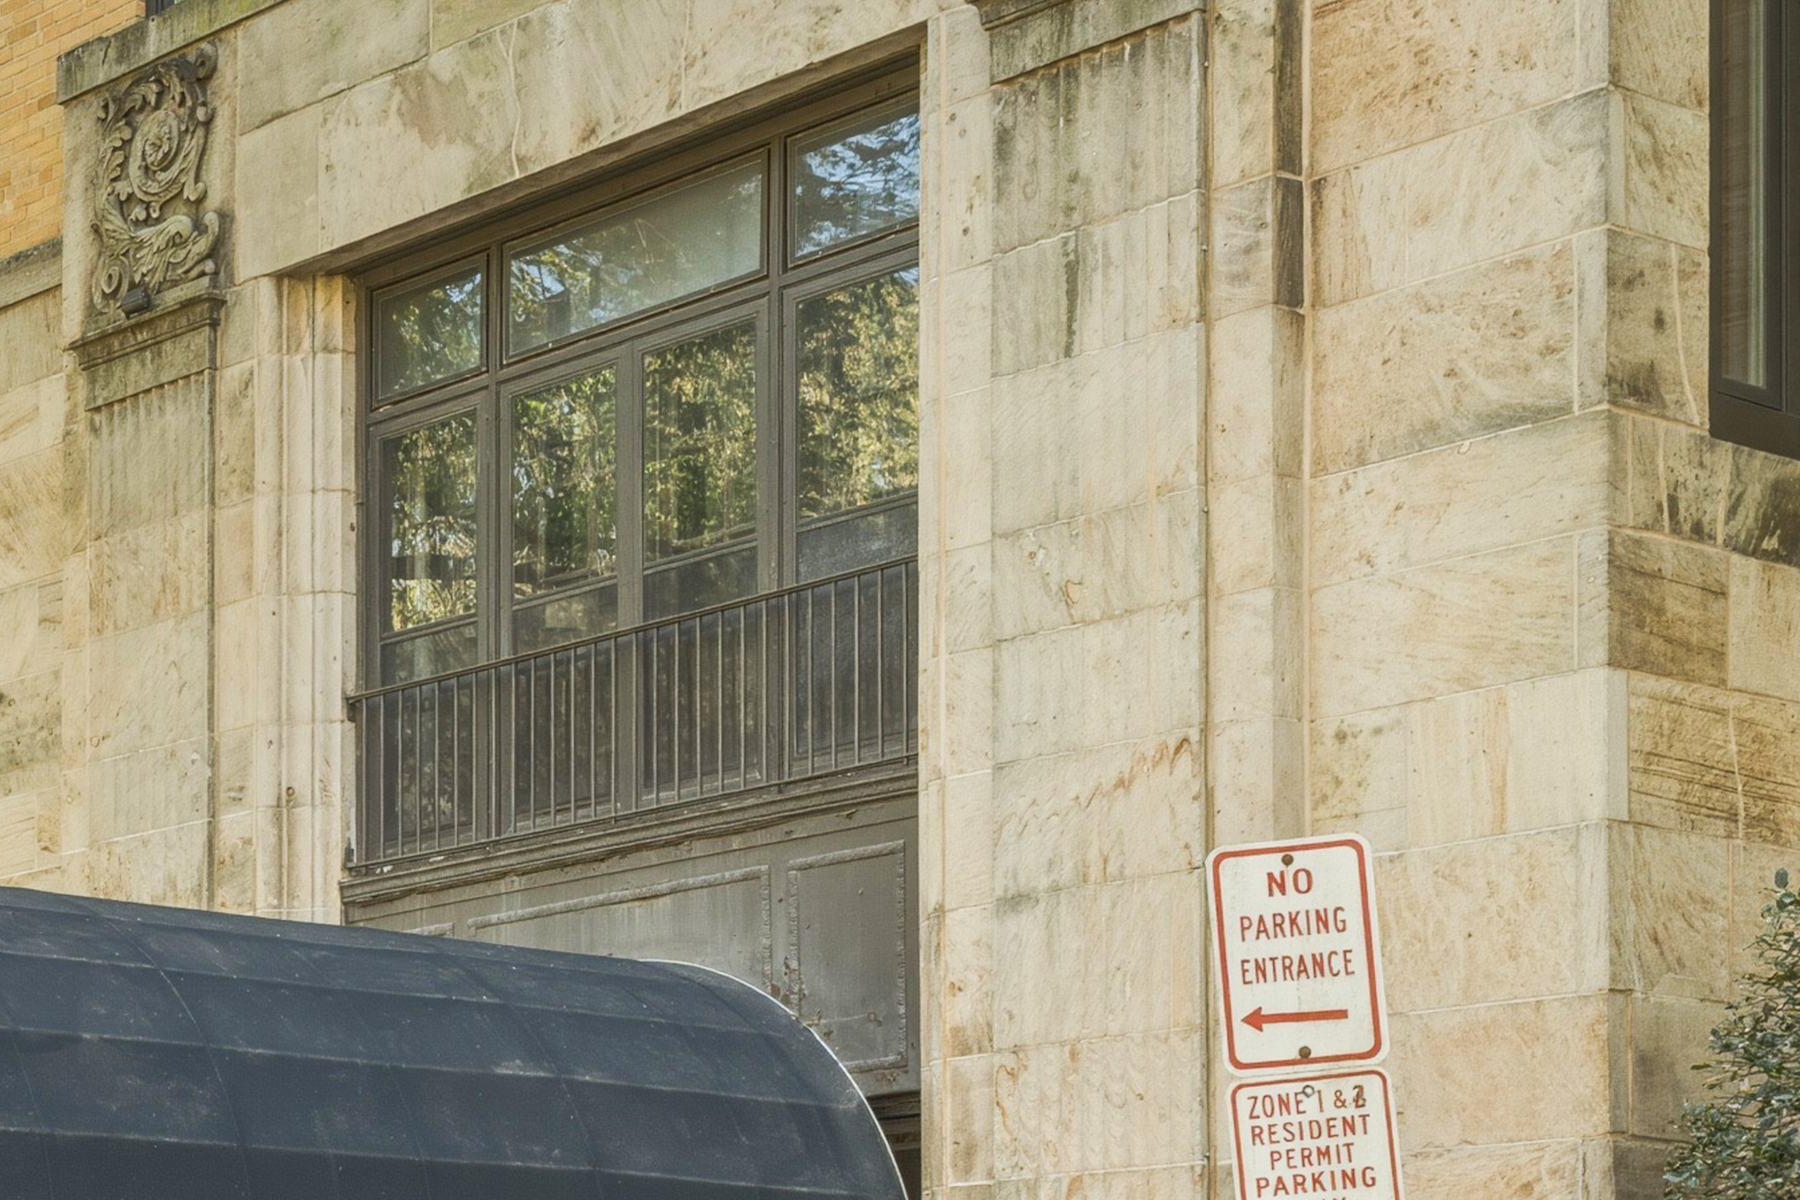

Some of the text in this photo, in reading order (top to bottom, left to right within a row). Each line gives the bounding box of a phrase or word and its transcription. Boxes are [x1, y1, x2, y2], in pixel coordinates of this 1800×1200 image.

[1266, 867, 1314, 898] NO
[1239, 906, 1347, 942] PARKING
[1240, 949, 1356, 985] ENTRANCE
[1247, 1091, 1307, 1120] ZONE
[1316, 1089, 1325, 1113] 1
[1333, 1089, 1348, 1110] &
[1250, 1114, 1371, 1146] RESIDENT
[1269, 1142, 1355, 1171] PERMIT
[1255, 1166, 1377, 1198] PARKING
